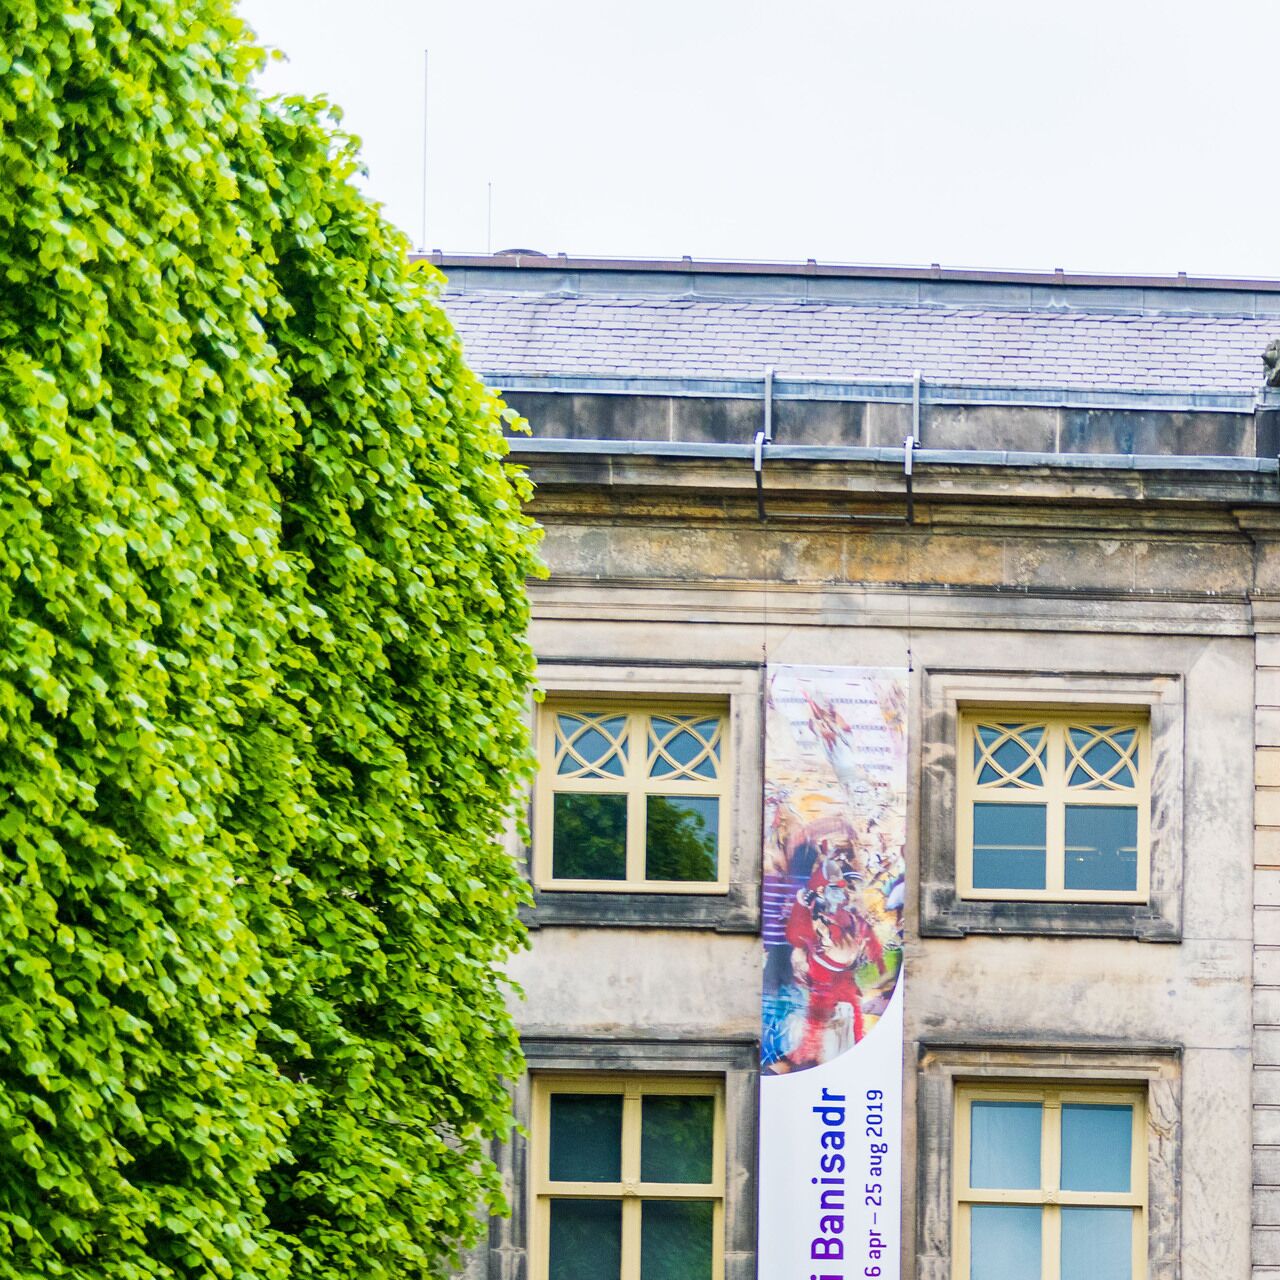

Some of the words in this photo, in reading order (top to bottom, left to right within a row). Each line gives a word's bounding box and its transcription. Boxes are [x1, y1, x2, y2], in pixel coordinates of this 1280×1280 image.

[866, 1089, 883, 1137] 2019
[811, 1087, 846, 1260] Banisadr
[869, 1142, 888, 1177] aug
[865, 1183, 882, 1206] 25
[868, 1228, 887, 1260] apr
[864, 1265, 881, 1277] 6
